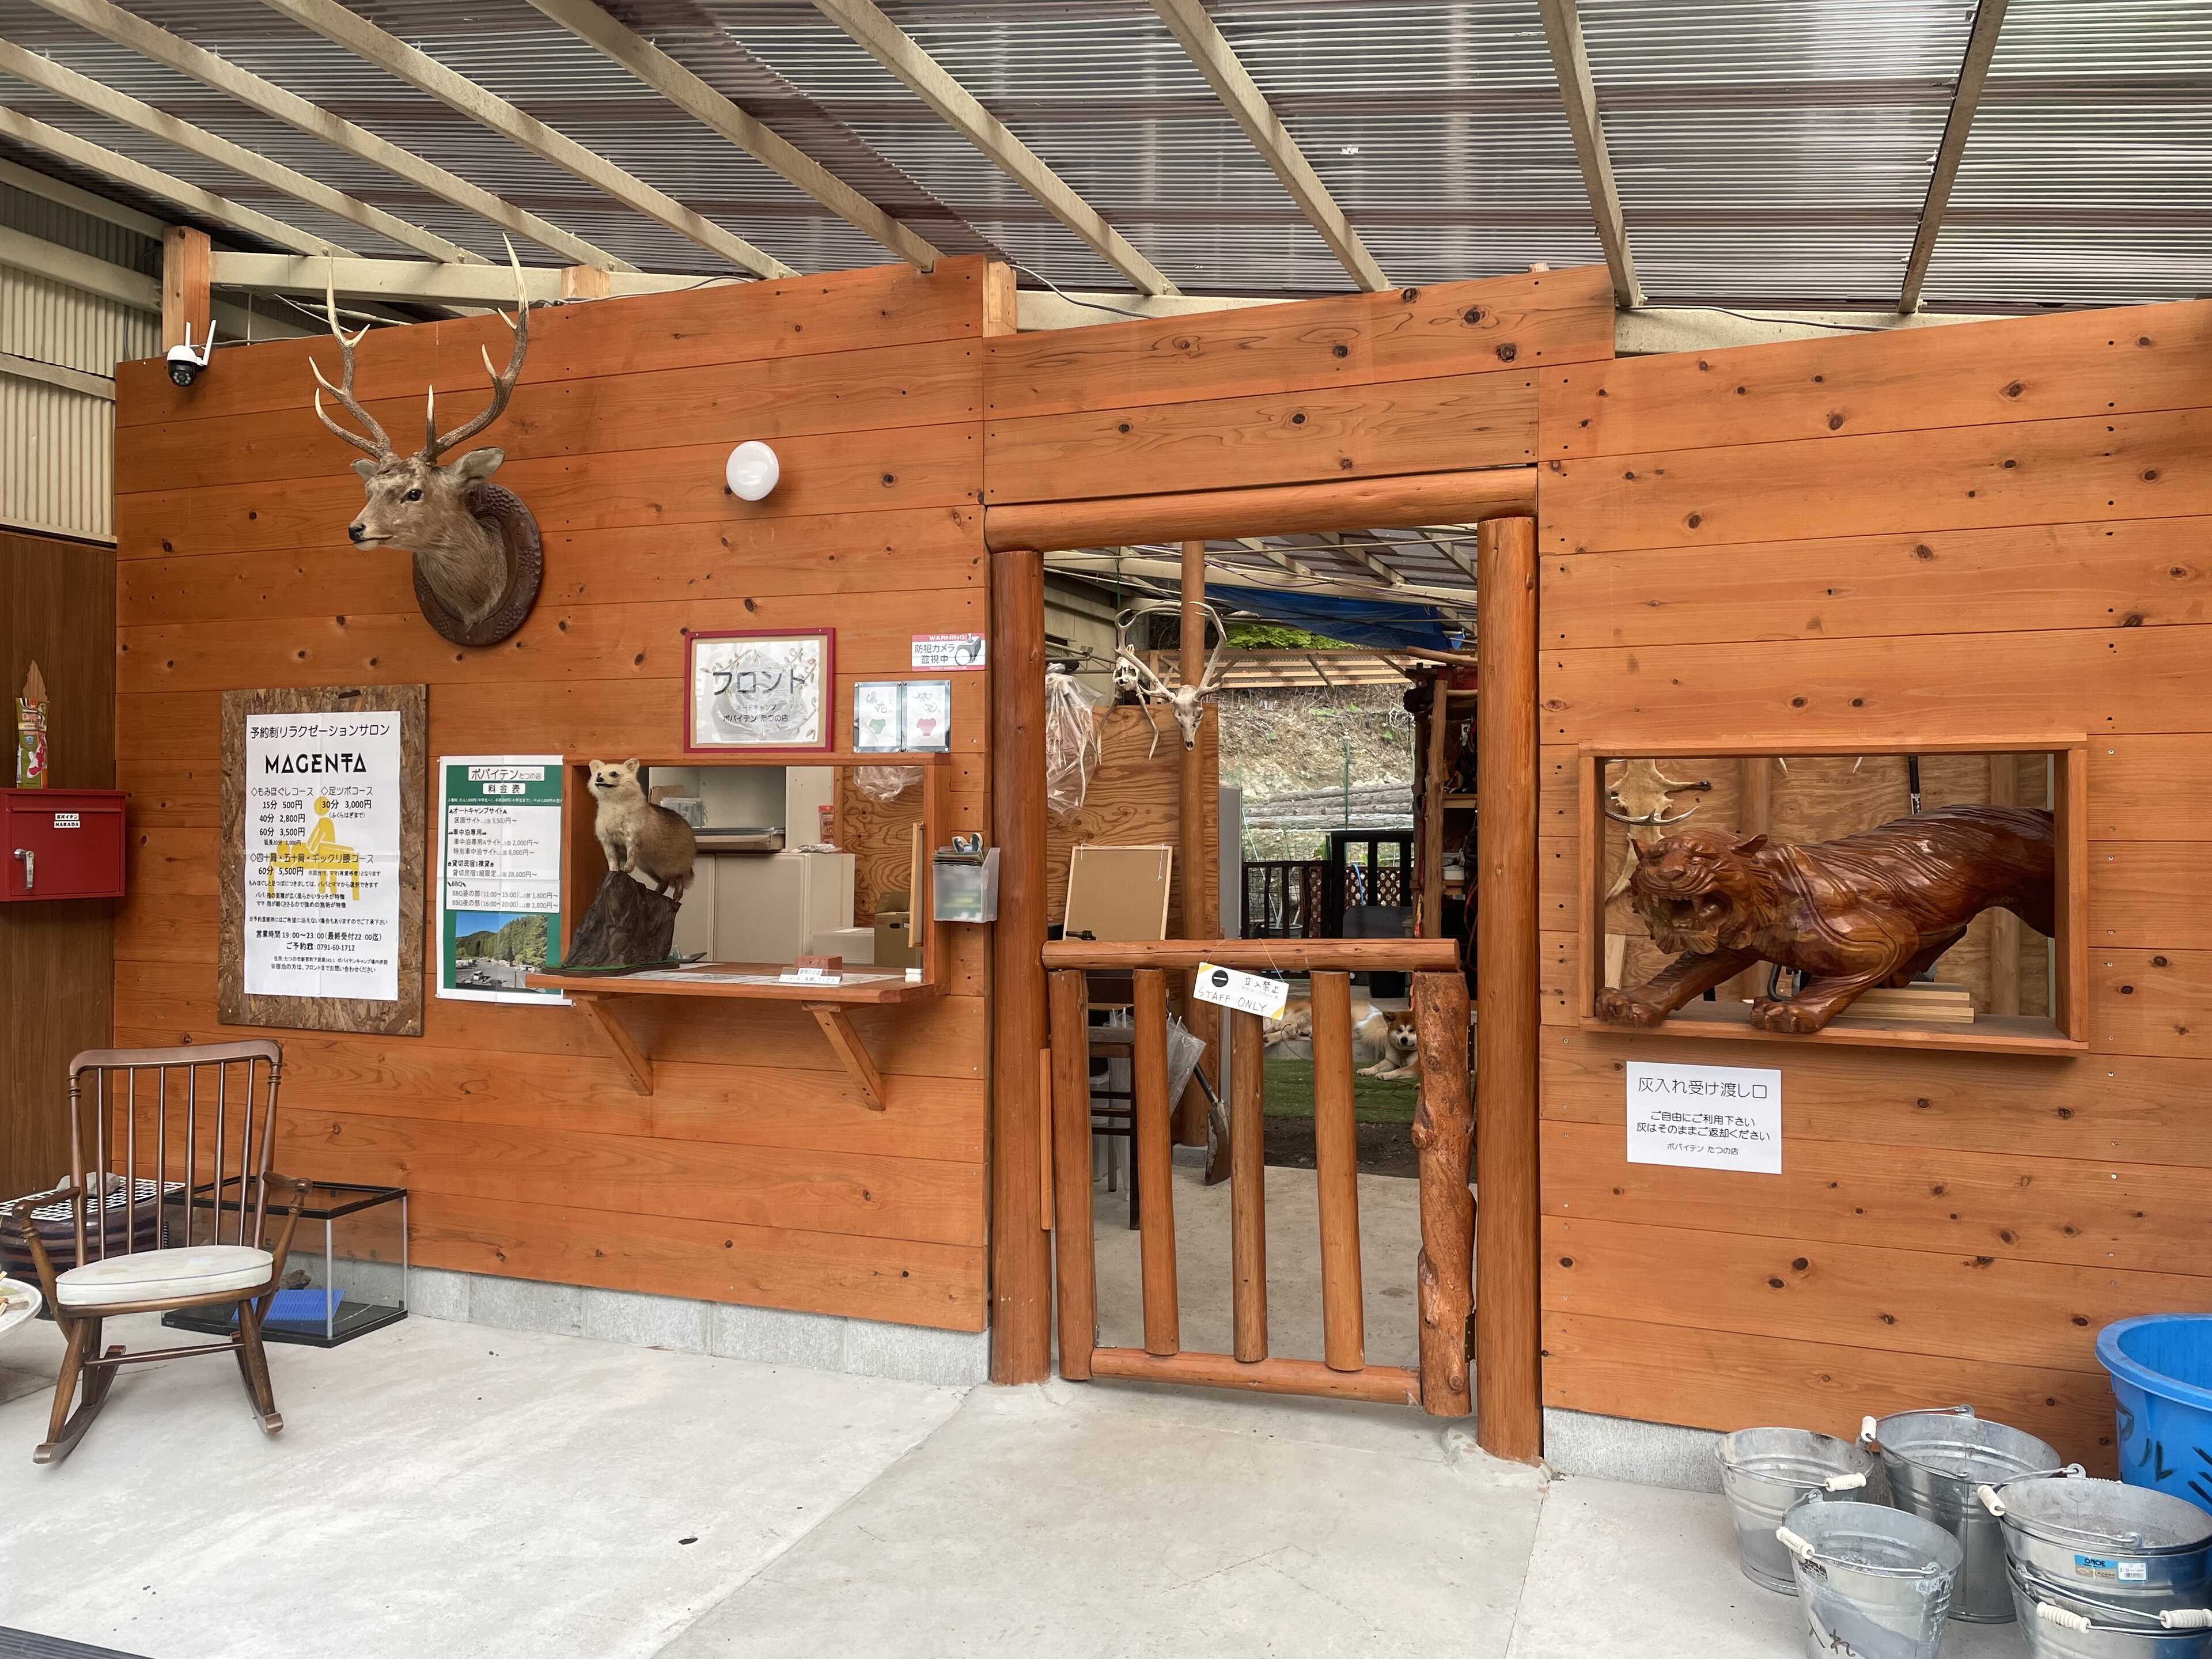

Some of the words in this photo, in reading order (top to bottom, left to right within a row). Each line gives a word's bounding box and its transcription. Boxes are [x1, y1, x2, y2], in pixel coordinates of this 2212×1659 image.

[915, 643, 955, 654] 防犯カメラ
[921, 654, 948, 664] 監視中
[713, 668, 805, 695] フロント
[250, 724, 389, 739] 予約制リラクゼーションサロン
[265, 753, 367, 774] MAGENTA
[263, 800, 277, 809] 15分
[282, 800, 302, 809] 500円
[321, 800, 339, 809] 30分
[345, 800, 372, 809] 3,000円
[259, 813, 274, 823] 40分
[279, 813, 305, 823] 2,800円
[259, 827, 274, 836] 60分
[279, 827, 305, 836] 3,500円
[258, 866, 274, 876] 60分
[278, 866, 304, 876] 5,500円
[256, 930, 281, 938] 営業時間
[1244, 976, 1280, 994] 立入禁止
[1198, 987, 1230, 1003] STAFF
[1238, 997, 1267, 1013] ONLY
[1638, 1077, 1767, 1099] 灰入れ受け渡し口
[1650, 1110, 1755, 1127] ご自由にご利用下さい
[1637, 1122, 1770, 1141] 灰はそのままご返却ください
[1707, 1146, 1738, 1156] たつの店
